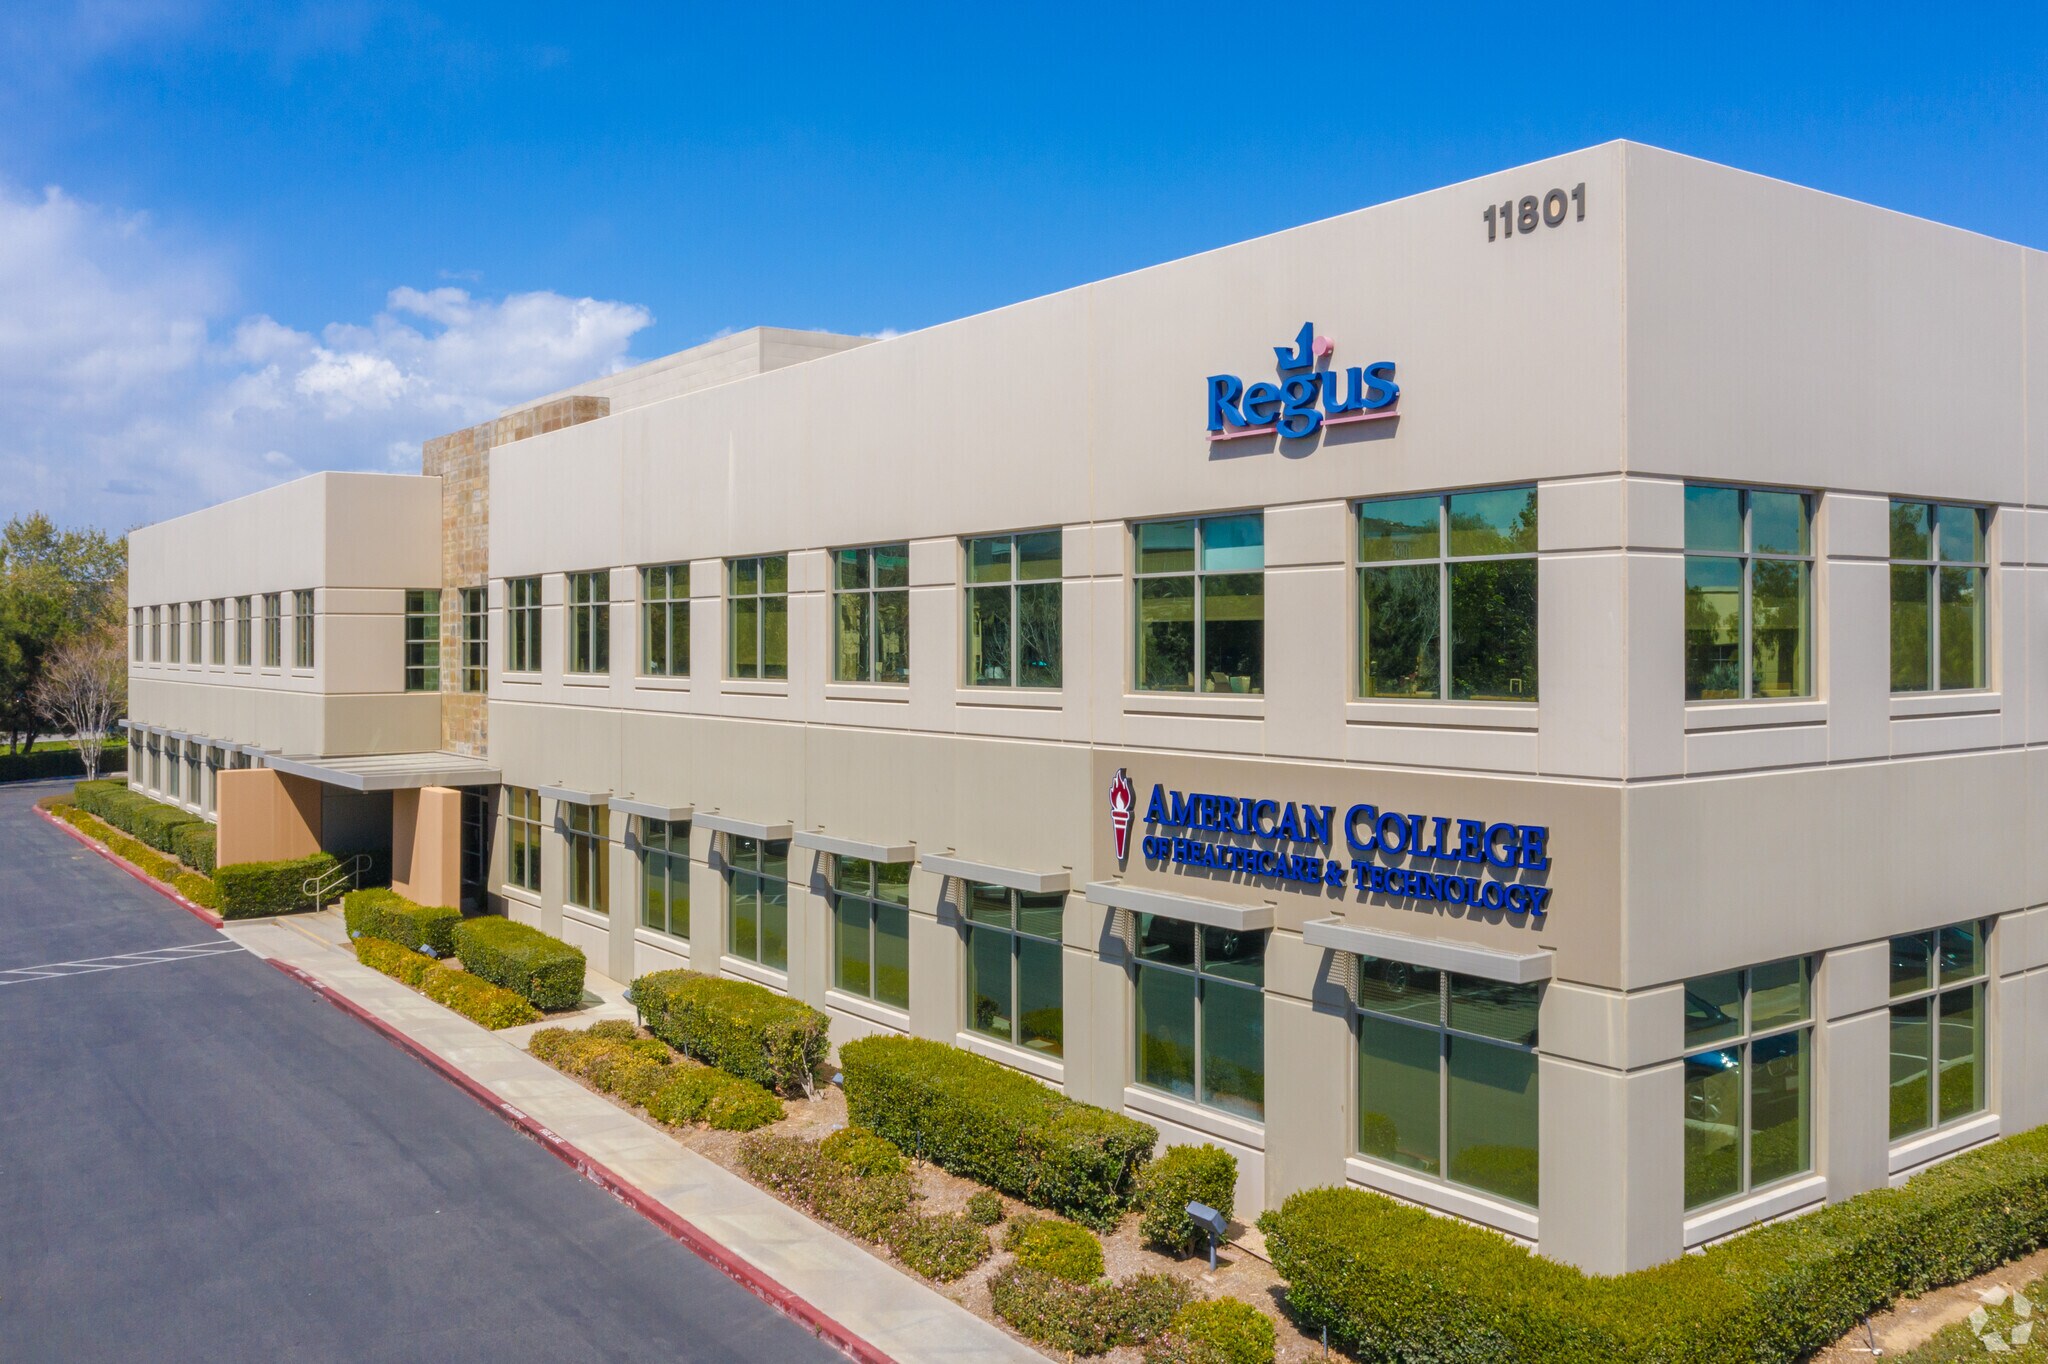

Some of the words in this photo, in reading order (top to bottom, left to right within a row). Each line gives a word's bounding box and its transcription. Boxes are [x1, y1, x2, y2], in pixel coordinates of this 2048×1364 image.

[1483, 182, 1586, 242] 11801
[1206, 360, 1400, 439] Regus
[1143, 783, 1334, 846] AMERICAN
[1344, 803, 1550, 871] COLLEGE
[1142, 835, 1171, 860] OF
[1172, 836, 1321, 884] HEALTHCARE
[1324, 860, 1347, 887] &
[1351, 859, 1549, 917] TECHNOLOGY
